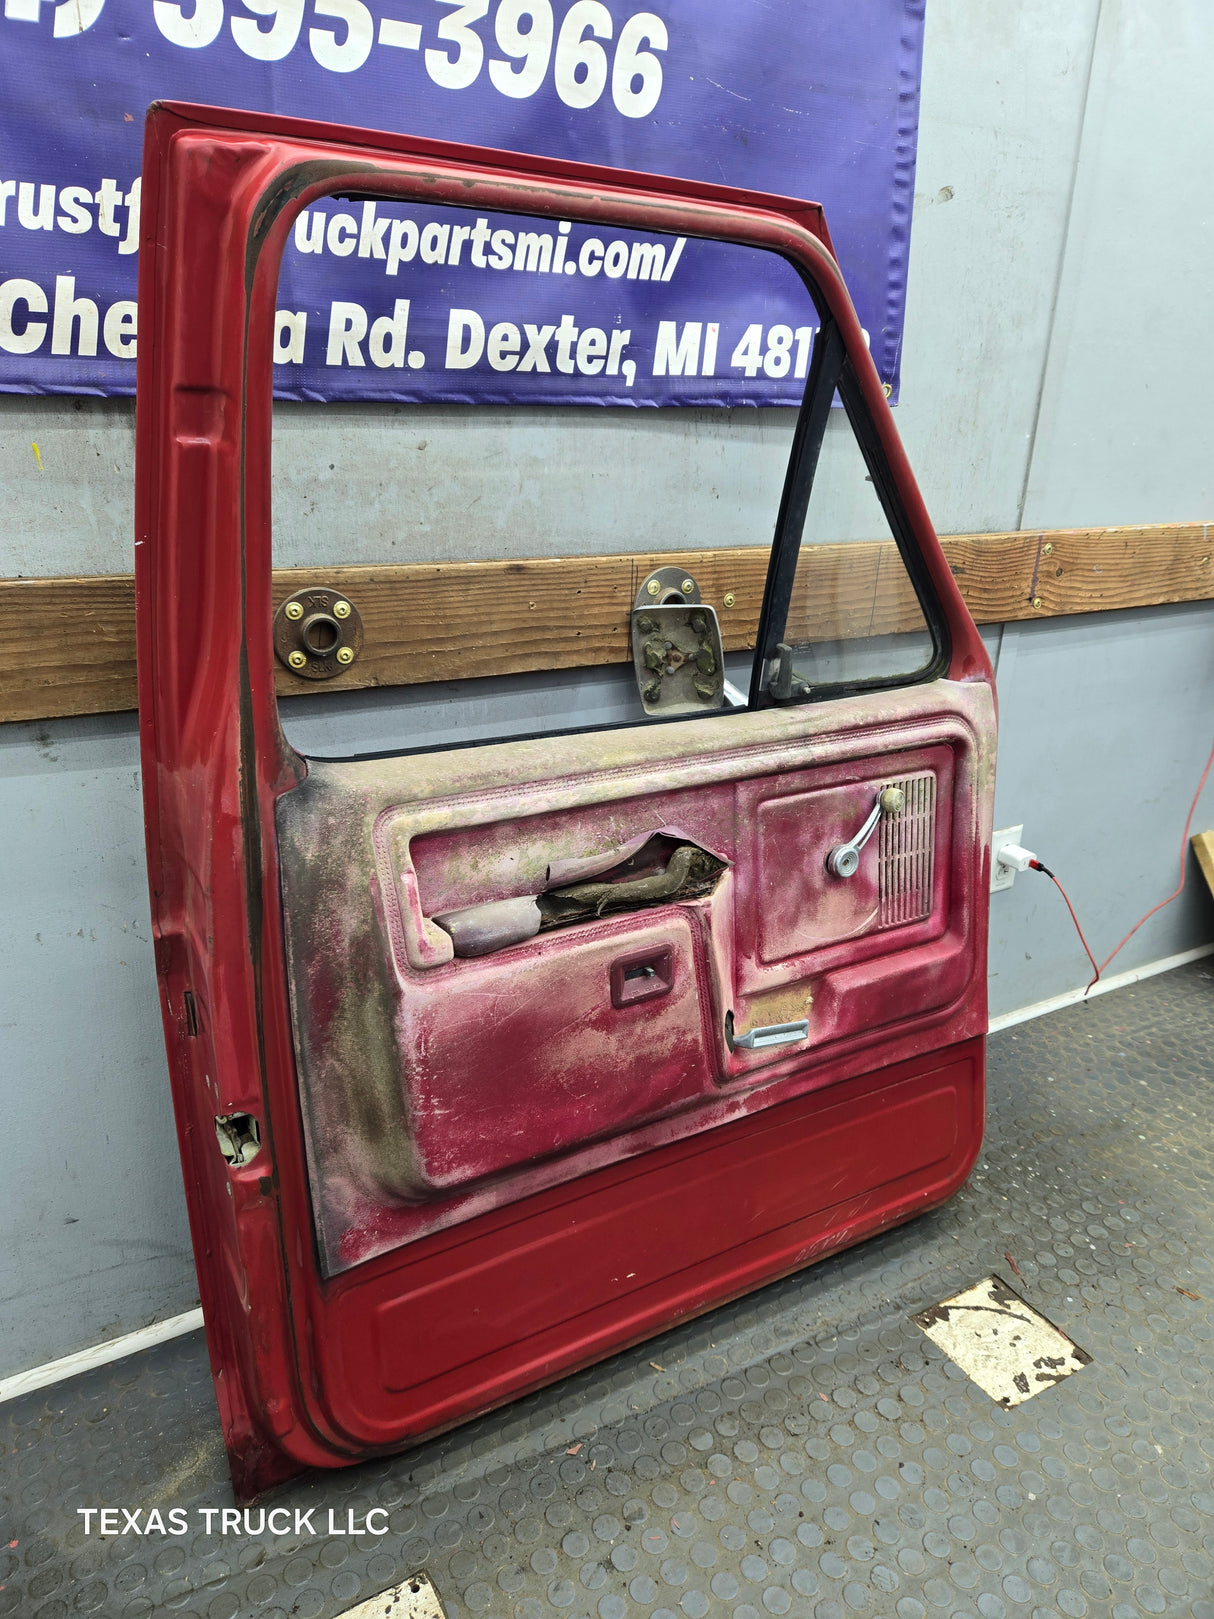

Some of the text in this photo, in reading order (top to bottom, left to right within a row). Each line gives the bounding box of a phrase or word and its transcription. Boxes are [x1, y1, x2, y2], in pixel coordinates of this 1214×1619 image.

[325, 299, 426, 370] Rd.
[445, 308, 637, 387] Dexter,
[653, 320, 720, 377] MI
